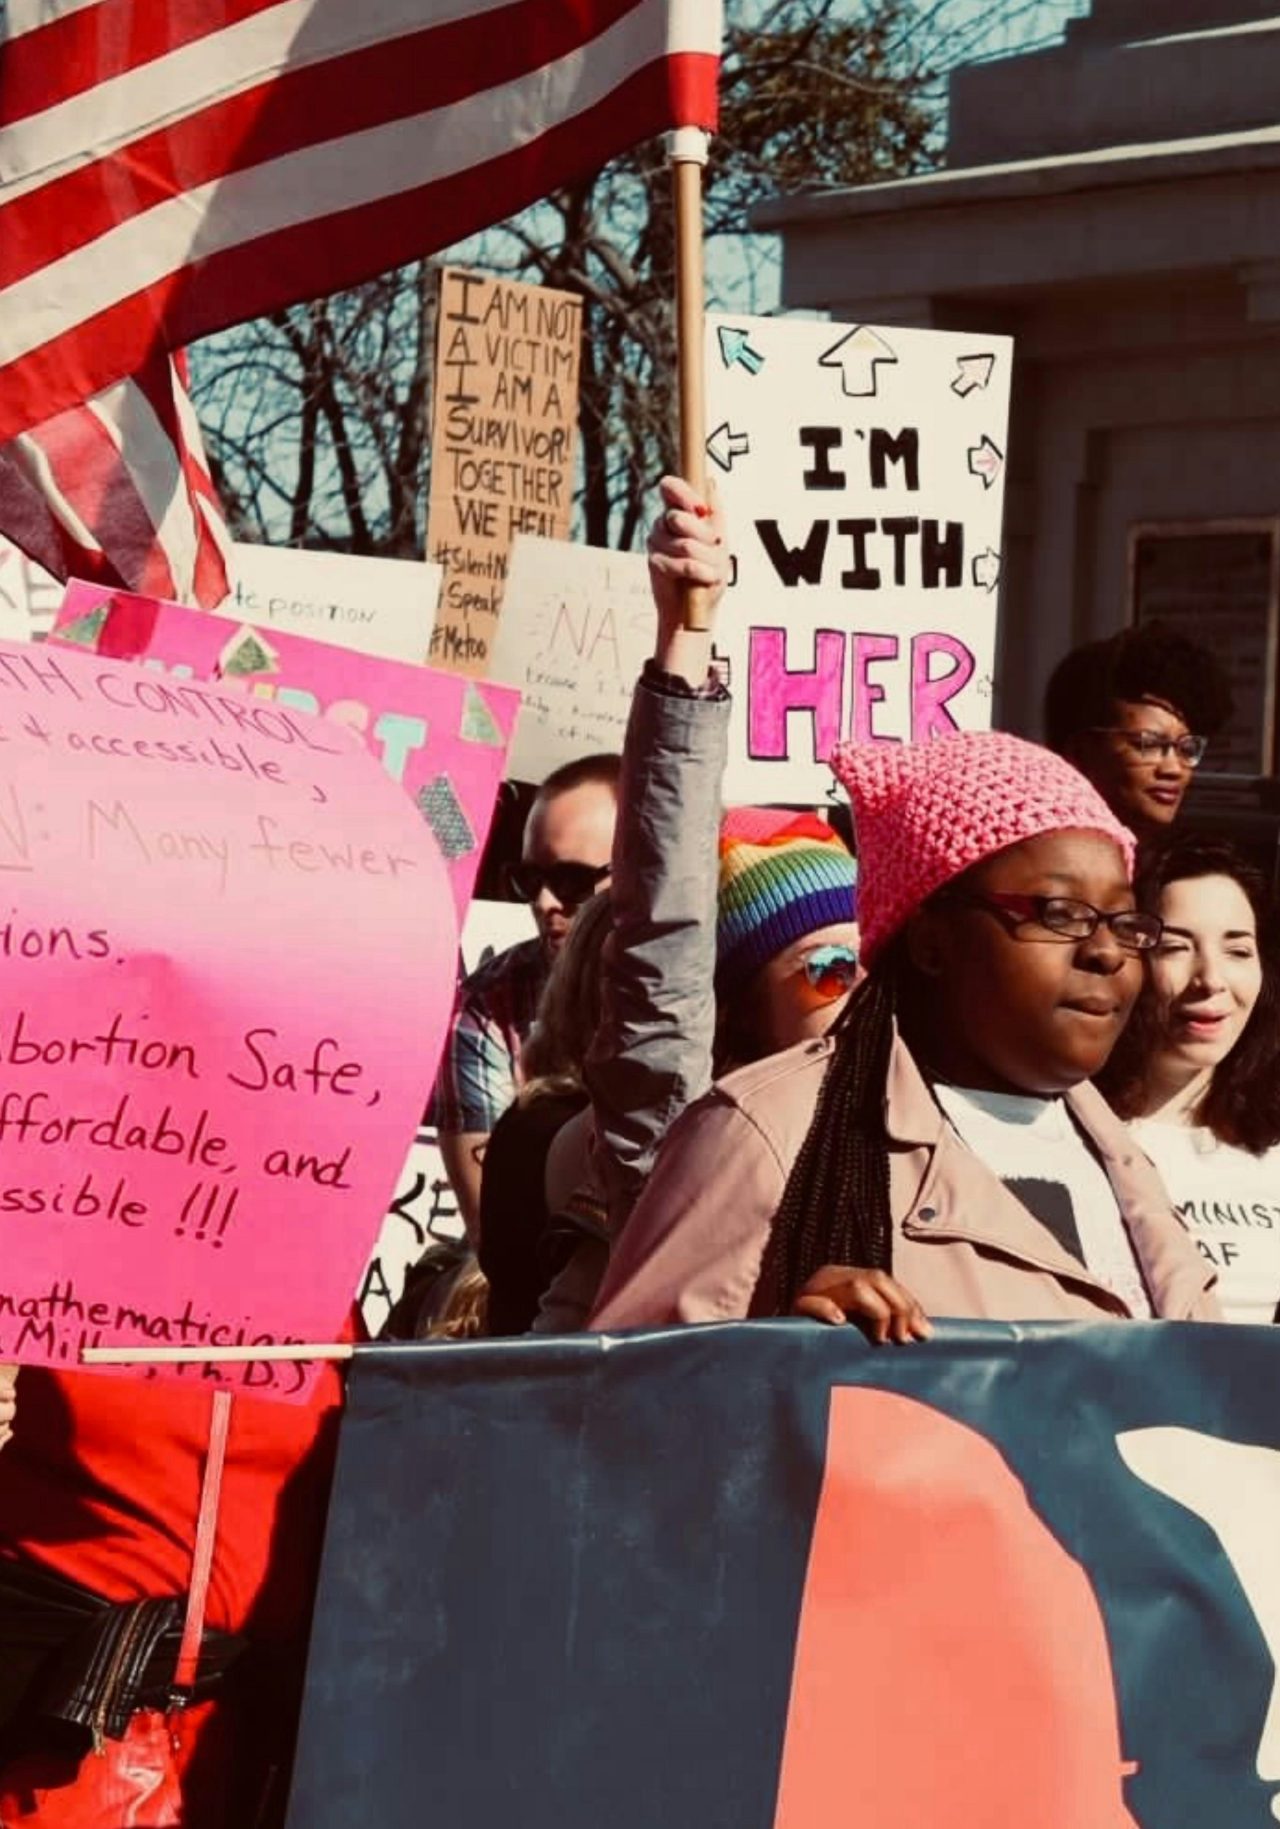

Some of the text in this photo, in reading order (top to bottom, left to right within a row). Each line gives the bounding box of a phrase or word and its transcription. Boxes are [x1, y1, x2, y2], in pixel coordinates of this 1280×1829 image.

[446, 271, 583, 345] I AM NOT
[447, 325, 575, 383] A VICTIM
[444, 360, 563, 420] I AM A
[445, 446, 564, 508] TOGETHER
[798, 426, 920, 491] I'M
[452, 494, 499, 538] WE
[754, 516, 964, 590] WITH
[96, 673, 342, 755] CONTROL
[746, 625, 977, 763] HER
[86, 799, 229, 893] Many
[250, 813, 419, 878] fewer
[226, 1028, 382, 1107] Safe,
[263, 1146, 352, 1190] and
